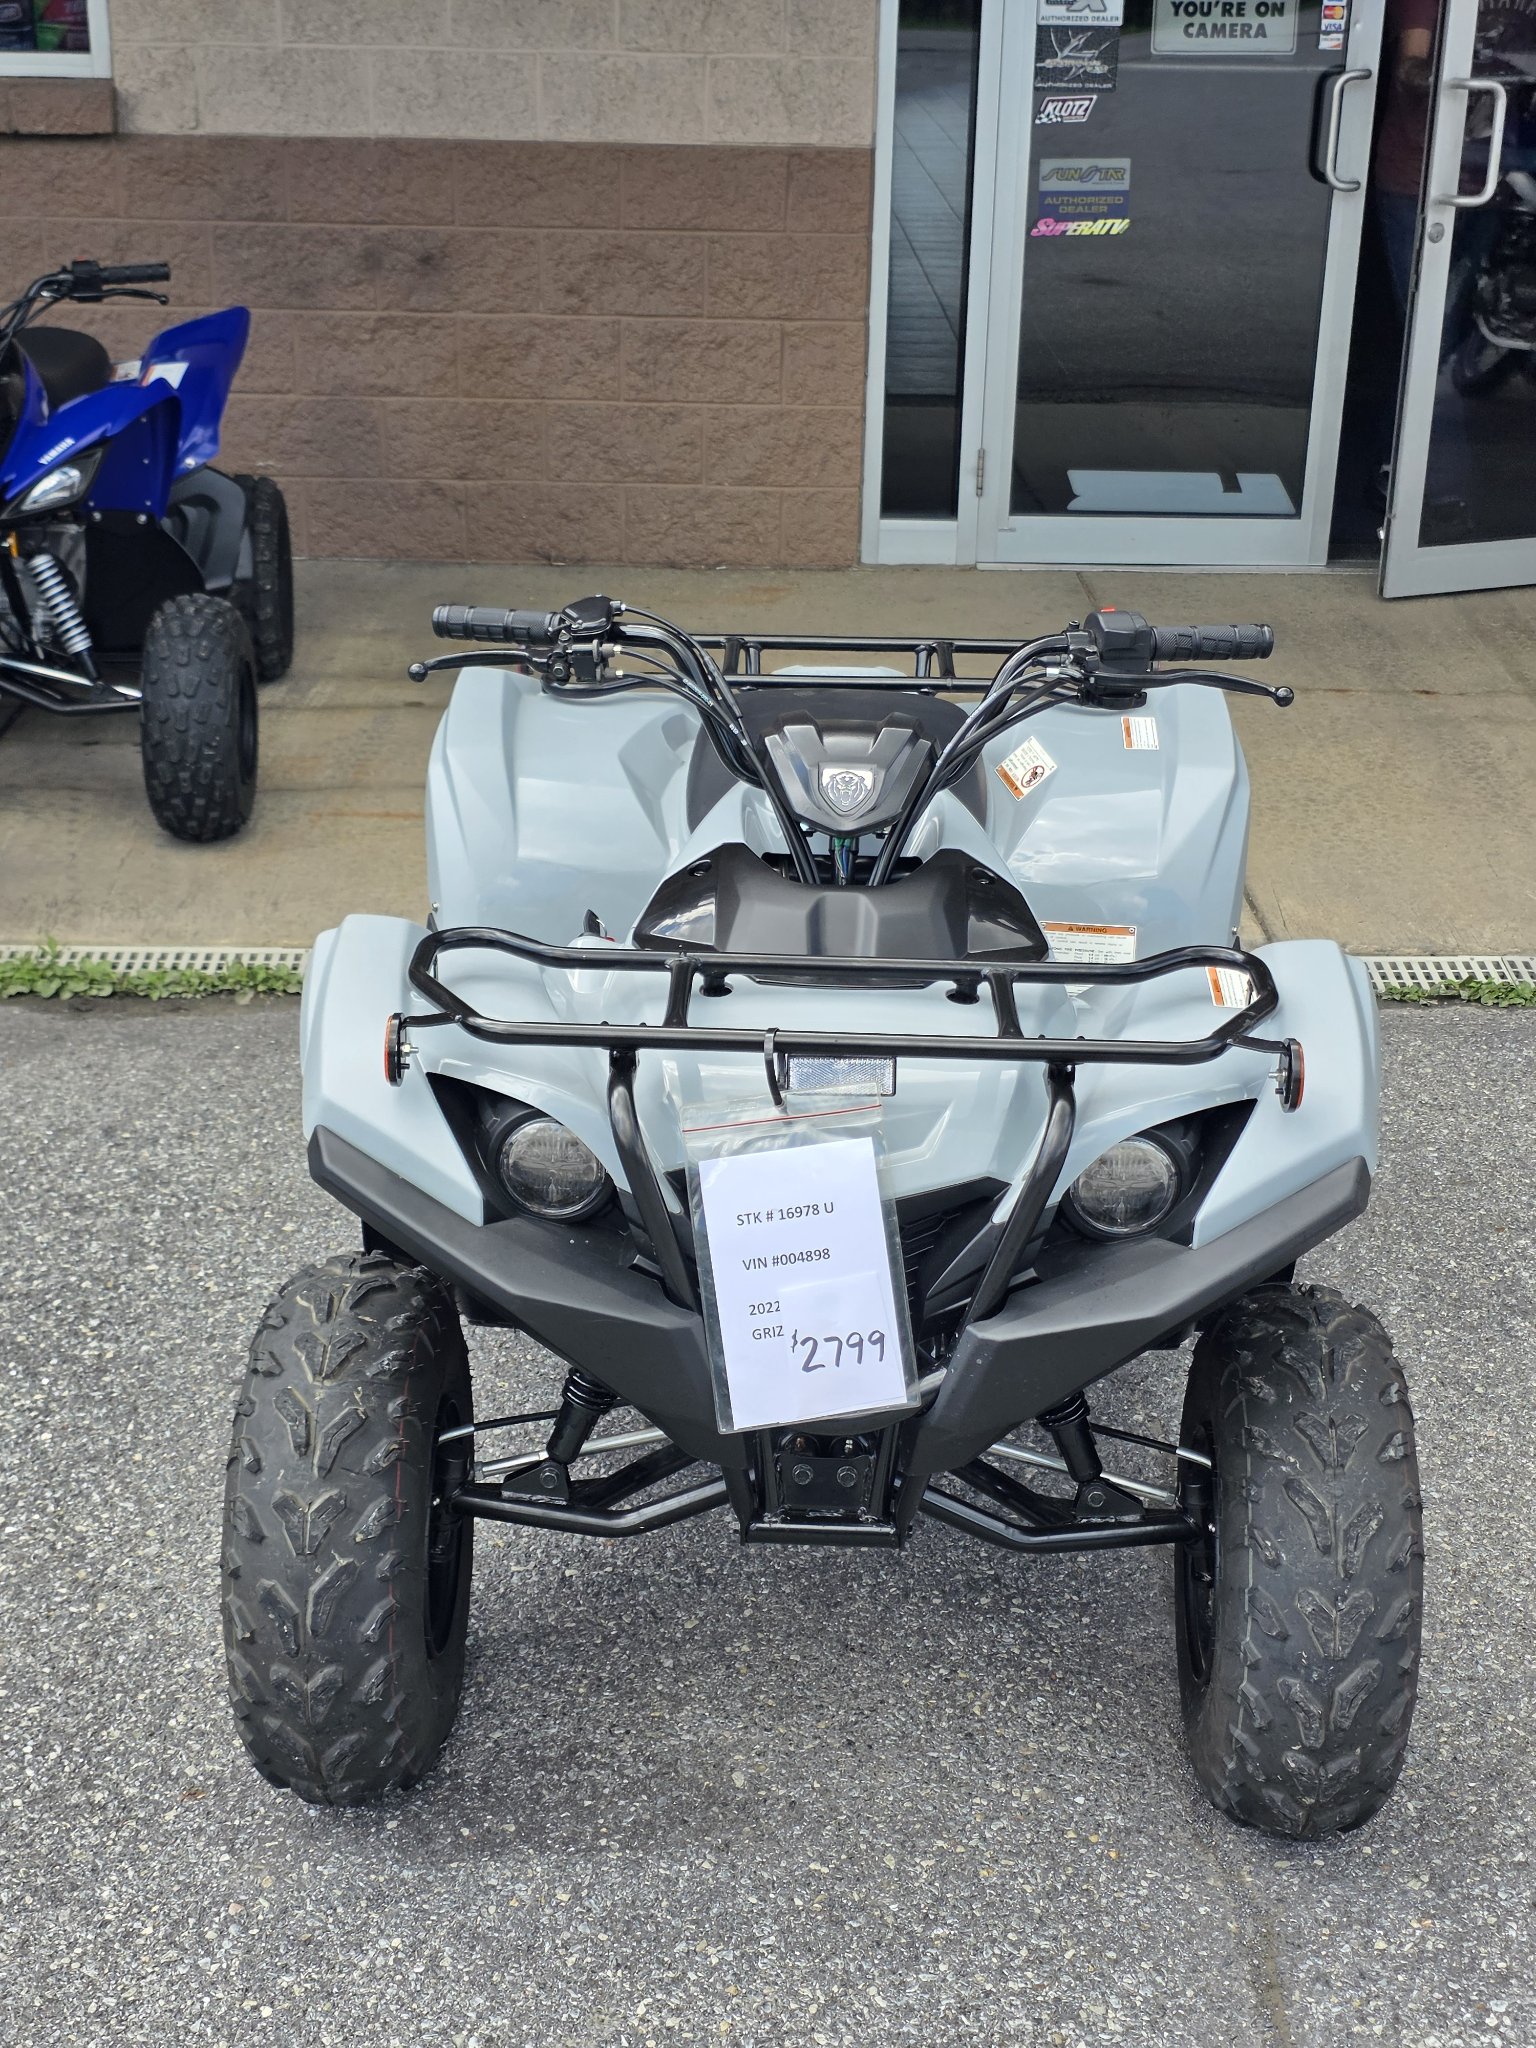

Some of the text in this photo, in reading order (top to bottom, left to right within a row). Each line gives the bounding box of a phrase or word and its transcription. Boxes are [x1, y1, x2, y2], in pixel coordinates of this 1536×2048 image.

[1170, 1, 1285, 18] YOU'RE ON
[1182, 22, 1268, 39] CAMERA
[1324, 23, 1342, 31] VISA
[1044, 101, 1090, 116] KLOTZ
[1044, 196, 1124, 205] AUTHORIZED
[1058, 205, 1108, 214] DEALER
[37, 436, 76, 465] YAMAHA
[1076, 926, 1108, 934] WARNING
[736, 1201, 835, 1226] STK # 16978 U
[742, 1247, 831, 1271] VIN #004898
[749, 1301, 780, 1315] 2022
[752, 1325, 785, 1340] GRIZ
[790, 1328, 886, 1374] $2799
